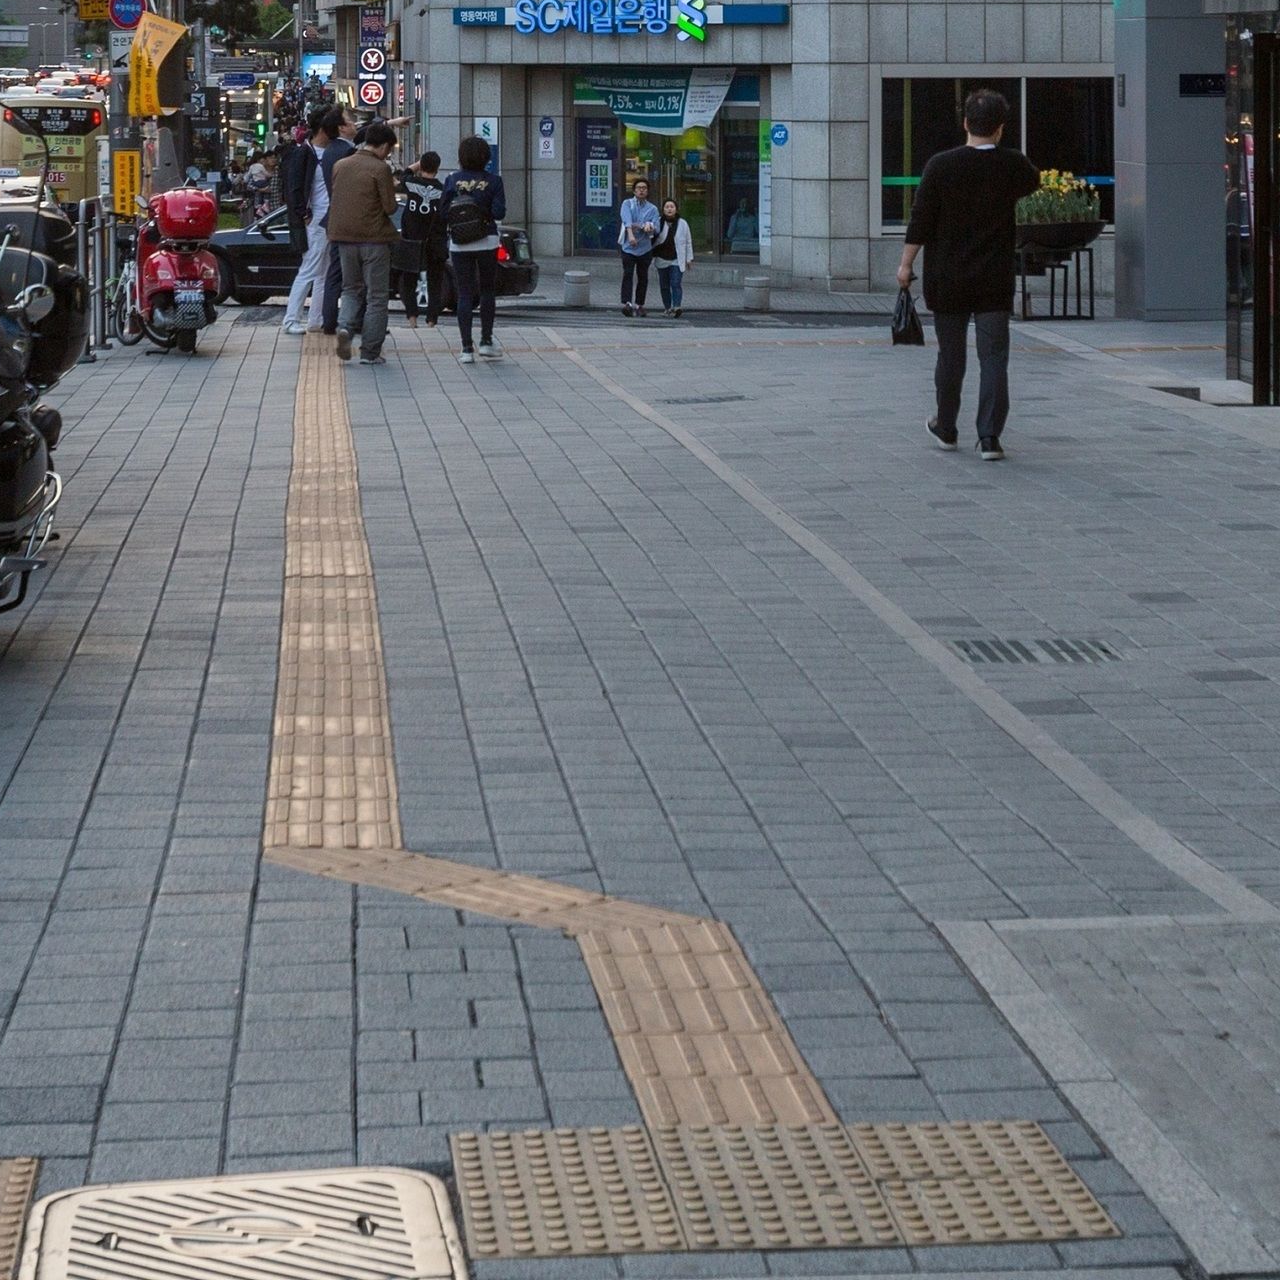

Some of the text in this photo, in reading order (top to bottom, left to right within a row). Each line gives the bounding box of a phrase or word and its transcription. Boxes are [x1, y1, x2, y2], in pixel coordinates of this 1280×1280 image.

[459, 9, 498, 23] 명동역지점
[608, 94, 633, 109] 1.5%
[45, 173, 66, 182] 015
